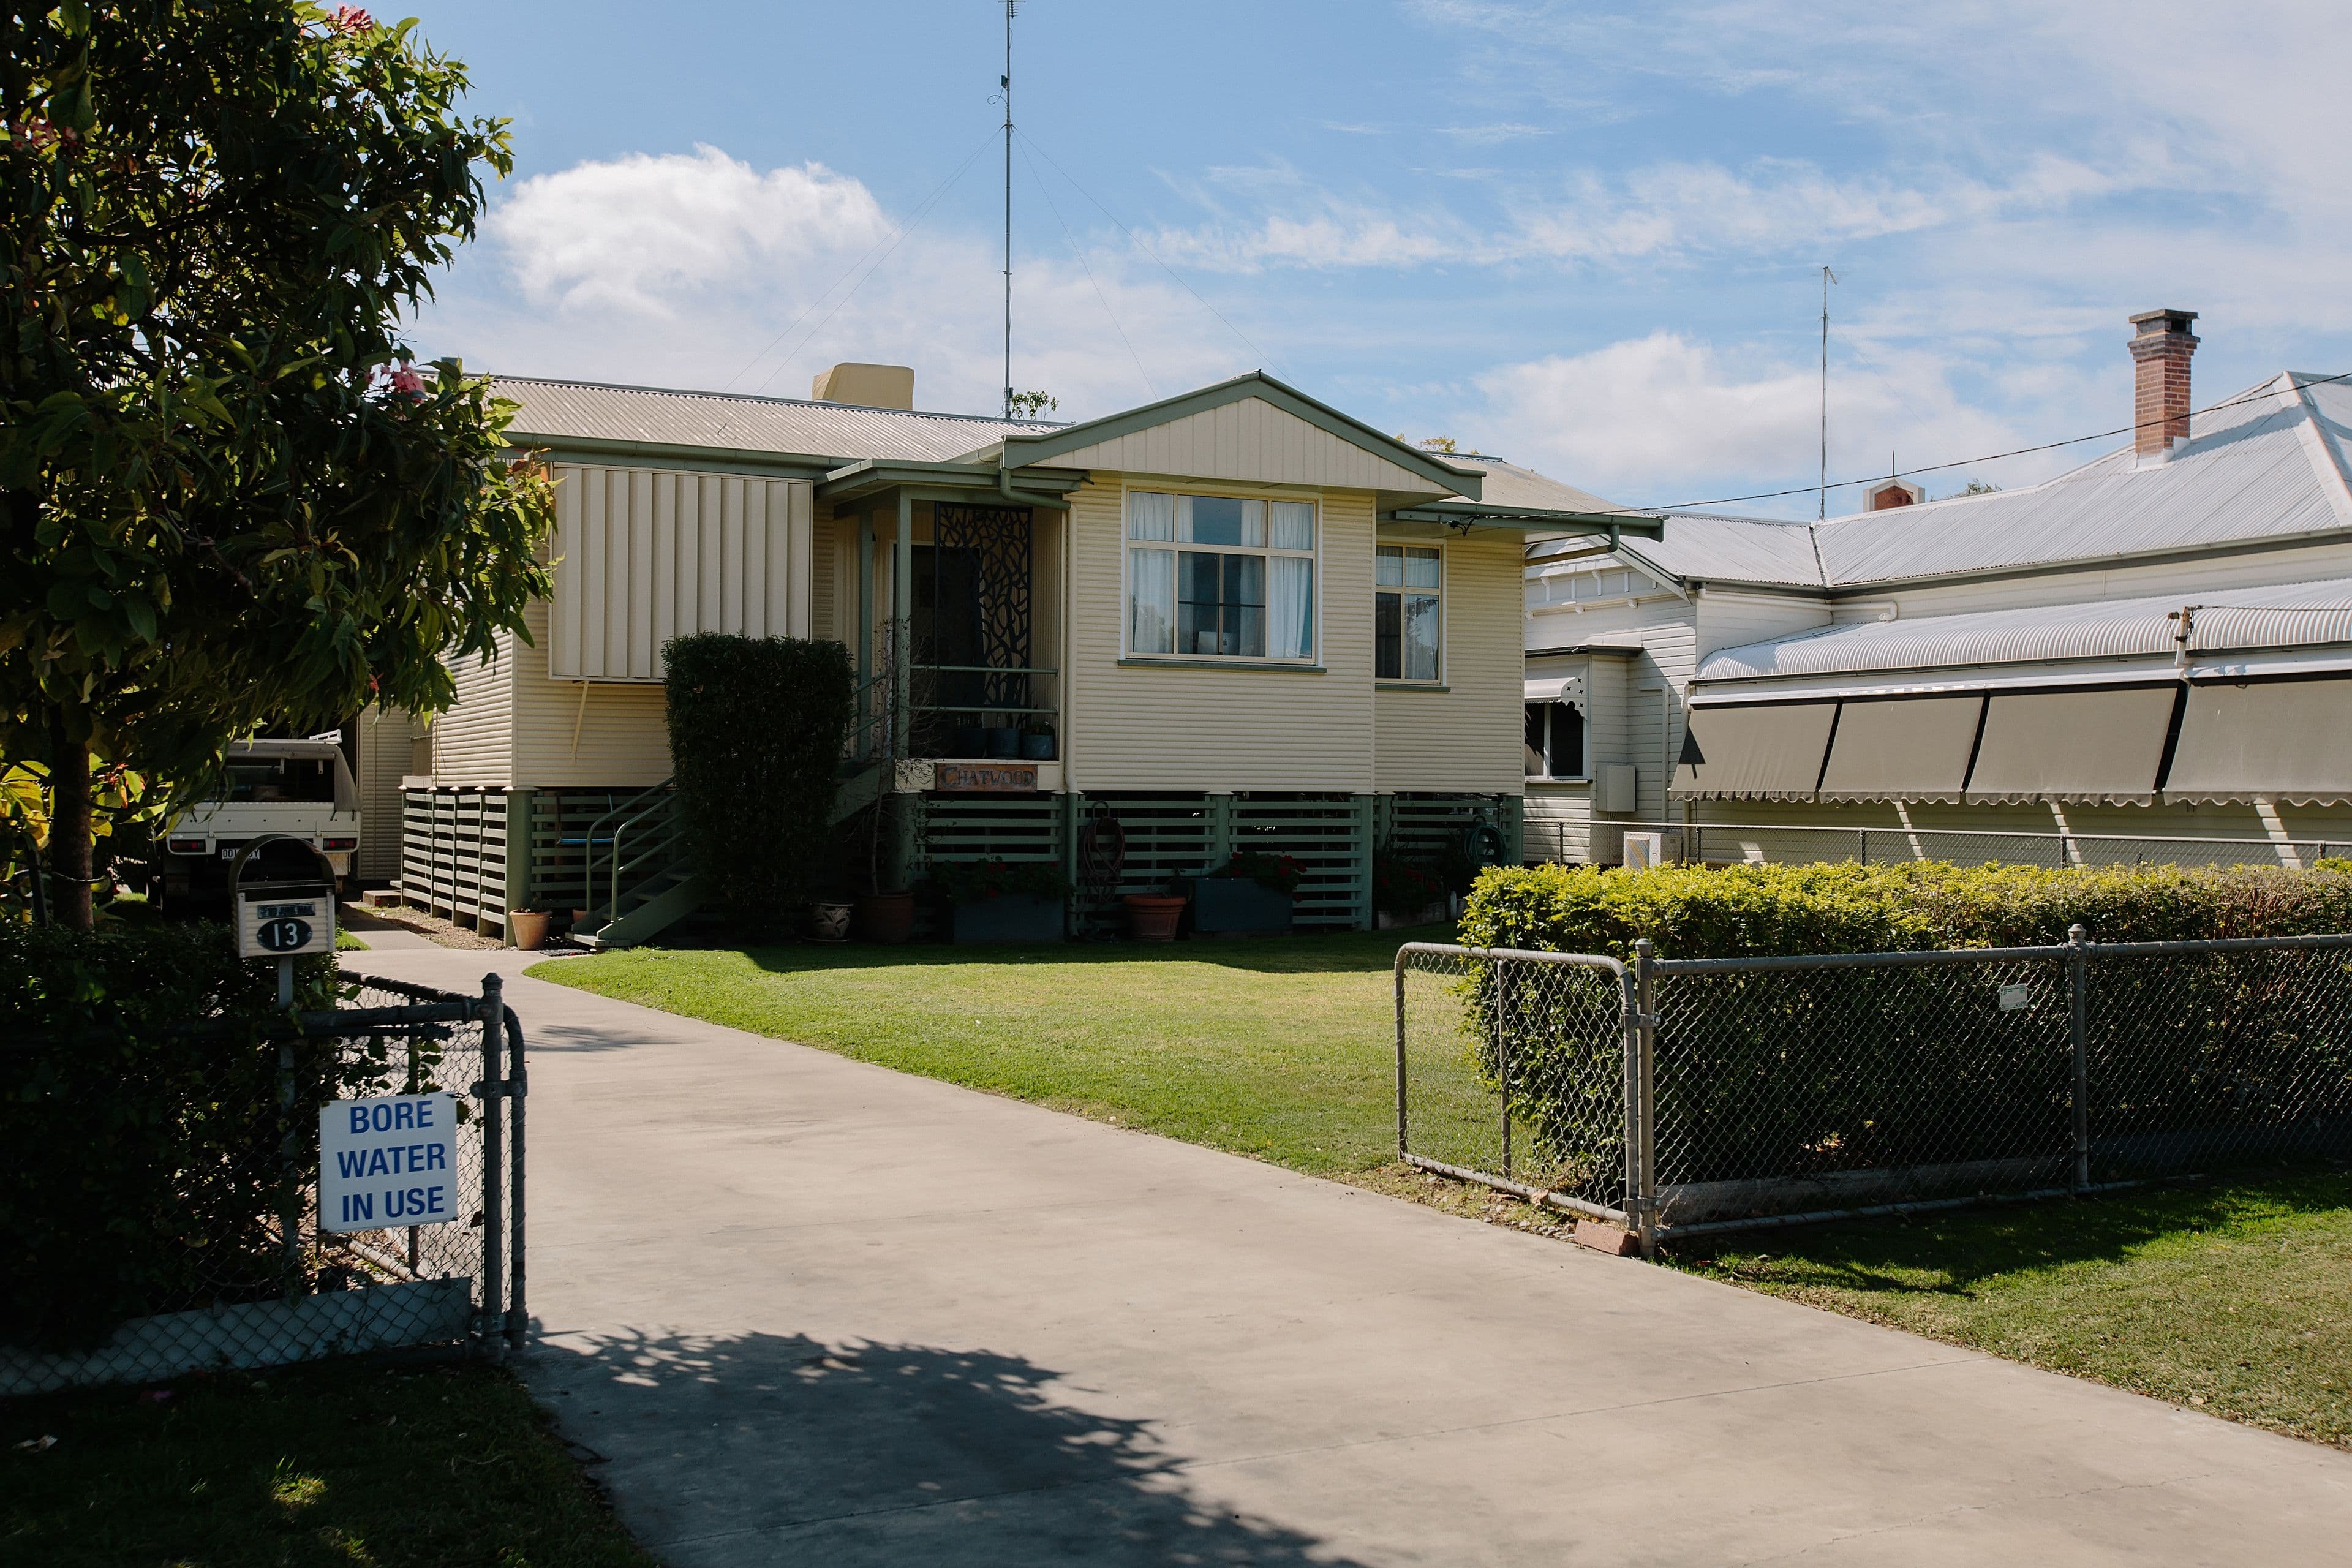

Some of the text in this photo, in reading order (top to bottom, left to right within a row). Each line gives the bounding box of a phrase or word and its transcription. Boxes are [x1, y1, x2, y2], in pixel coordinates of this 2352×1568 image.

[274, 922, 298, 947] 13
[350, 1100, 434, 1134] BORE
[337, 1143, 446, 1178] WATER
[342, 1186, 444, 1222] IN USE
